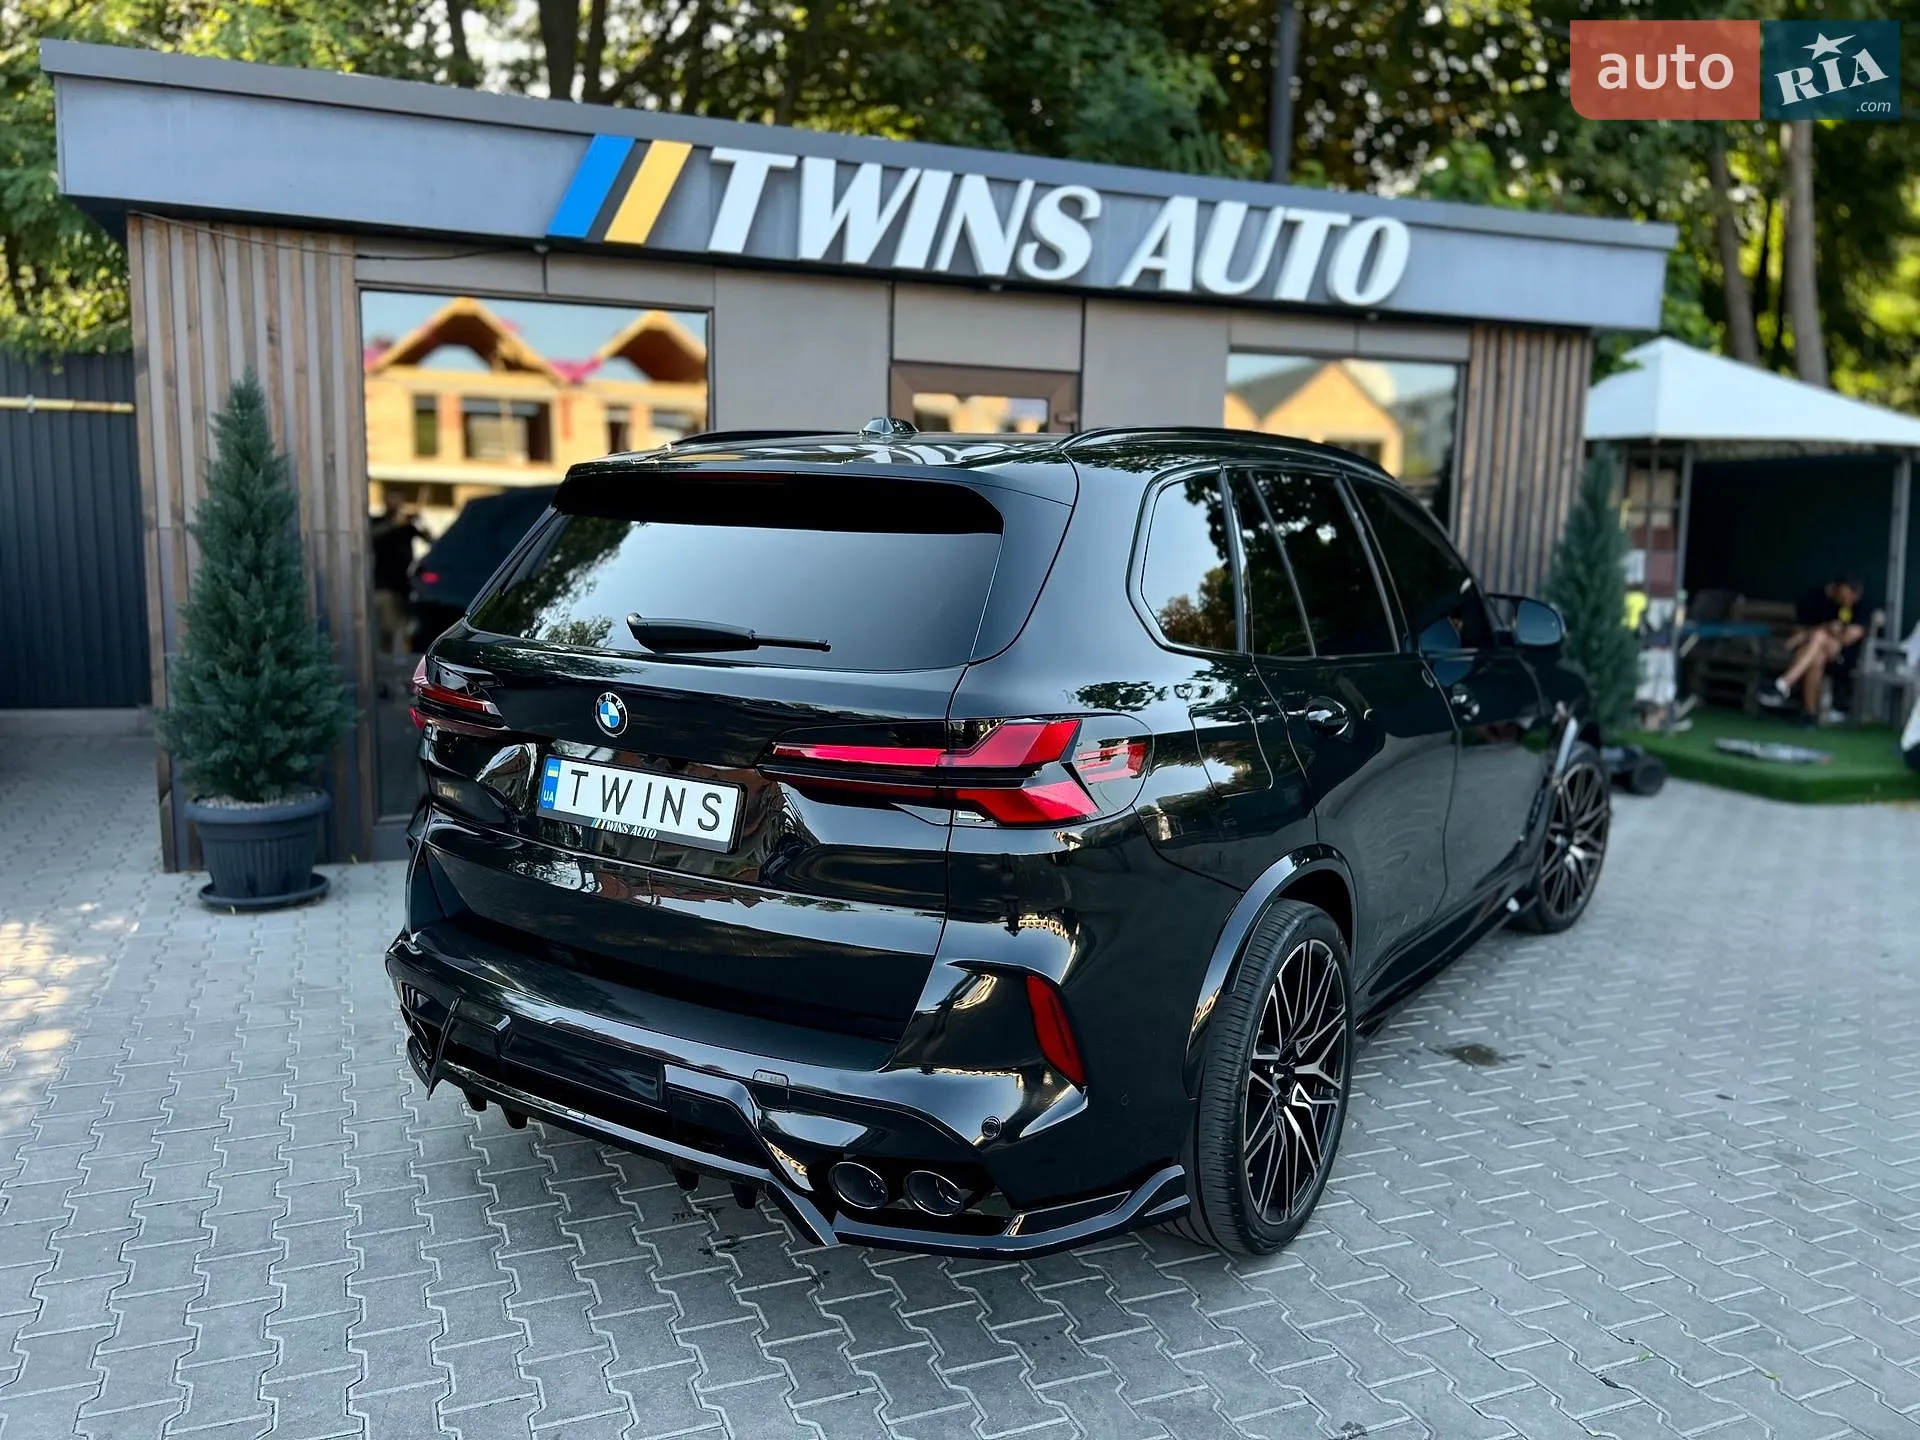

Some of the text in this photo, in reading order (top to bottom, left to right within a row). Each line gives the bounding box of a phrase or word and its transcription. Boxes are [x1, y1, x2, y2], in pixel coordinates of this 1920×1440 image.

[707, 146, 1411, 306] TWINS AUTO
[543, 789, 554, 802] UA
[600, 819, 658, 839] TWINS AUTO
